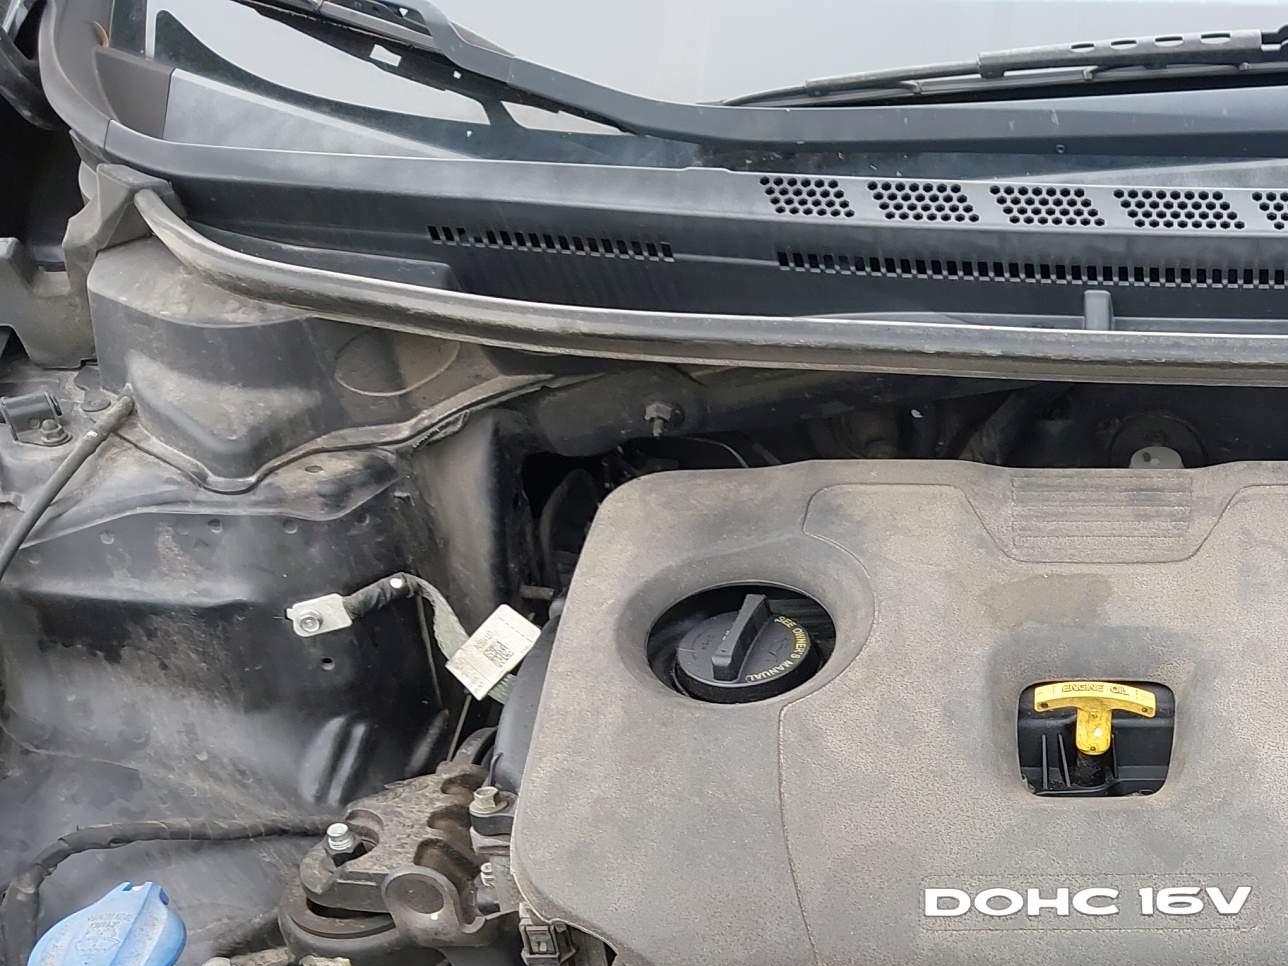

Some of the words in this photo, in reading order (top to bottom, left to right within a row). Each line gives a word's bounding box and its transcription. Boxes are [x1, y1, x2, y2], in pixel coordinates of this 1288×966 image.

[774, 616, 796, 628] SEE
[744, 658, 794, 684] MANUAL
[1062, 682, 1104, 692] ENGINE
[1110, 686, 1130, 696] OIL
[924, 886, 1119, 917] DOHC
[1139, 886, 1252, 916] 16V
